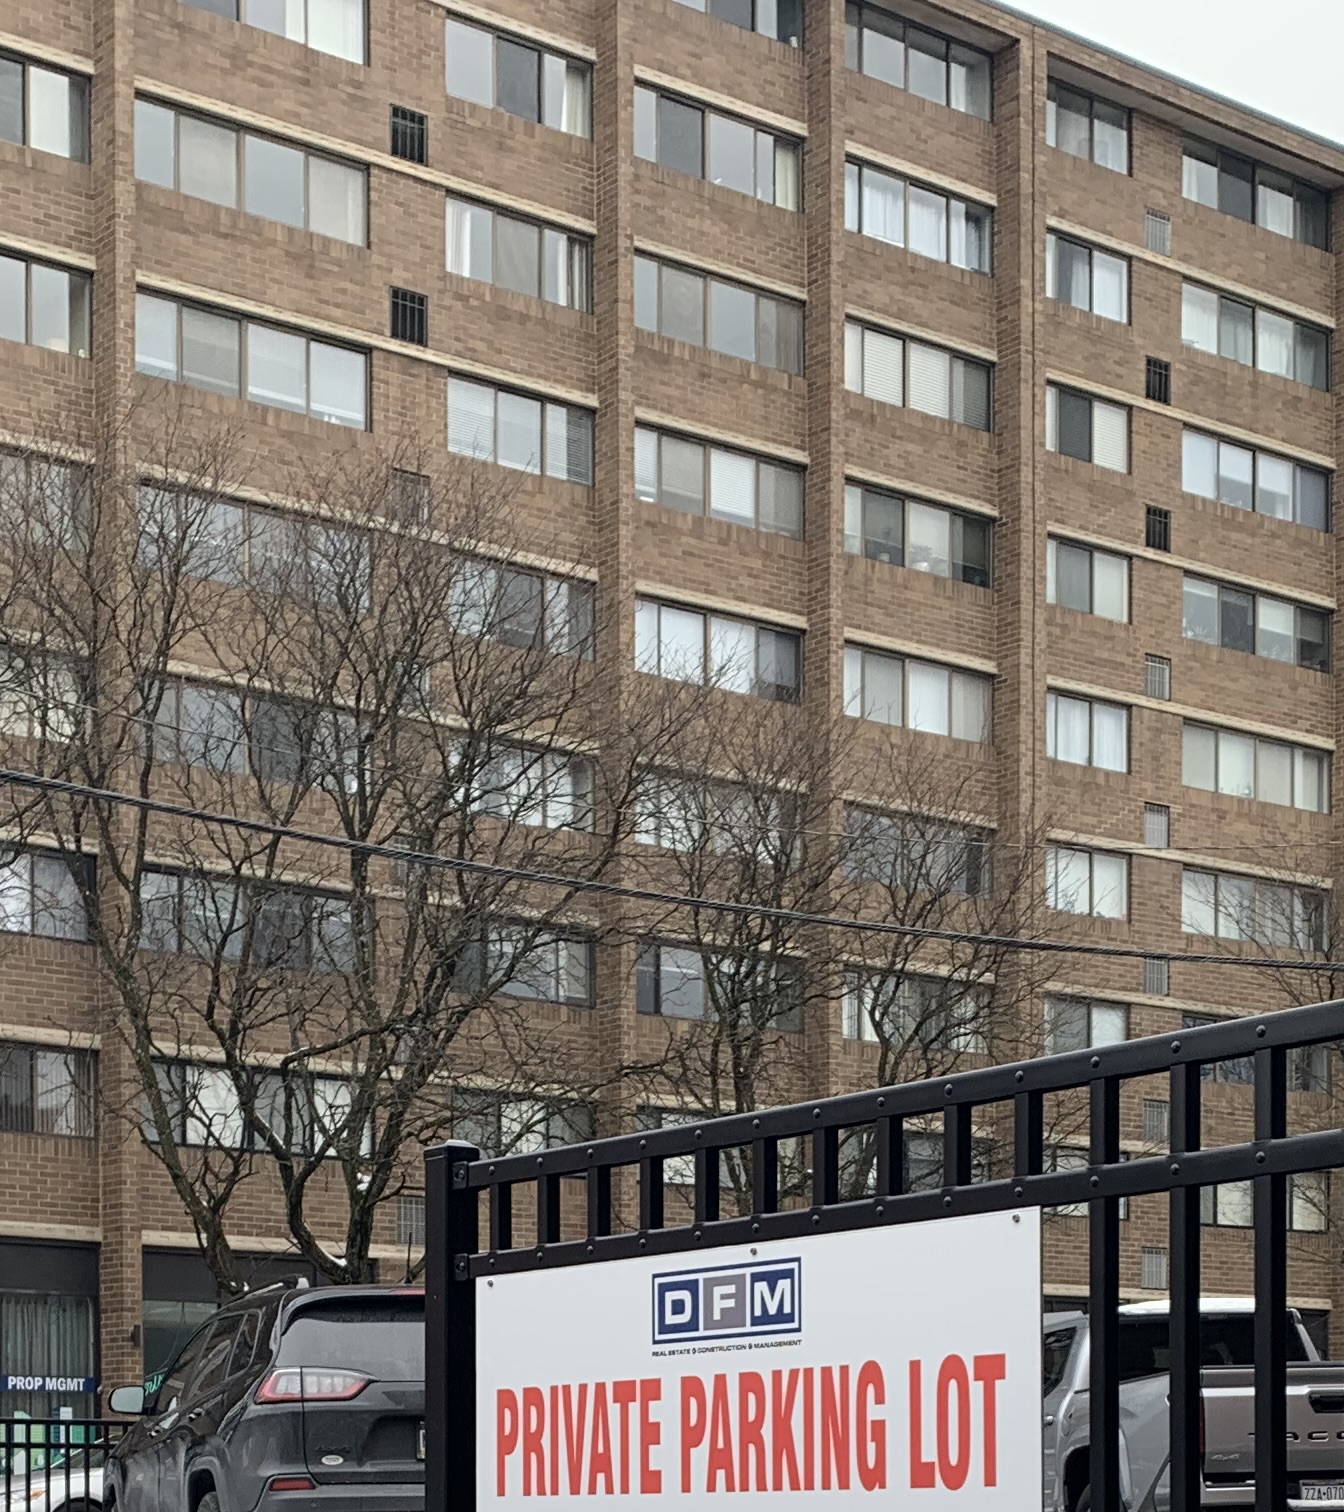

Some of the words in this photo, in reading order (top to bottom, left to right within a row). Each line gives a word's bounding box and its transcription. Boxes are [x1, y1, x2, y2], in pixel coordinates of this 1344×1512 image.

[664, 1277, 792, 1326] DFM
[668, 1348, 691, 1356] ESTATE
[697, 1344, 747, 1355] CONSTRUCTION
[753, 1339, 803, 1350] MANAGEMENT
[7, 1375, 43, 1391] PROP
[45, 1377, 86, 1392] MGMT
[496, 1378, 662, 1497] PRIVATE
[680, 1360, 887, 1494] PARKING
[909, 1353, 1007, 1491] LOT
